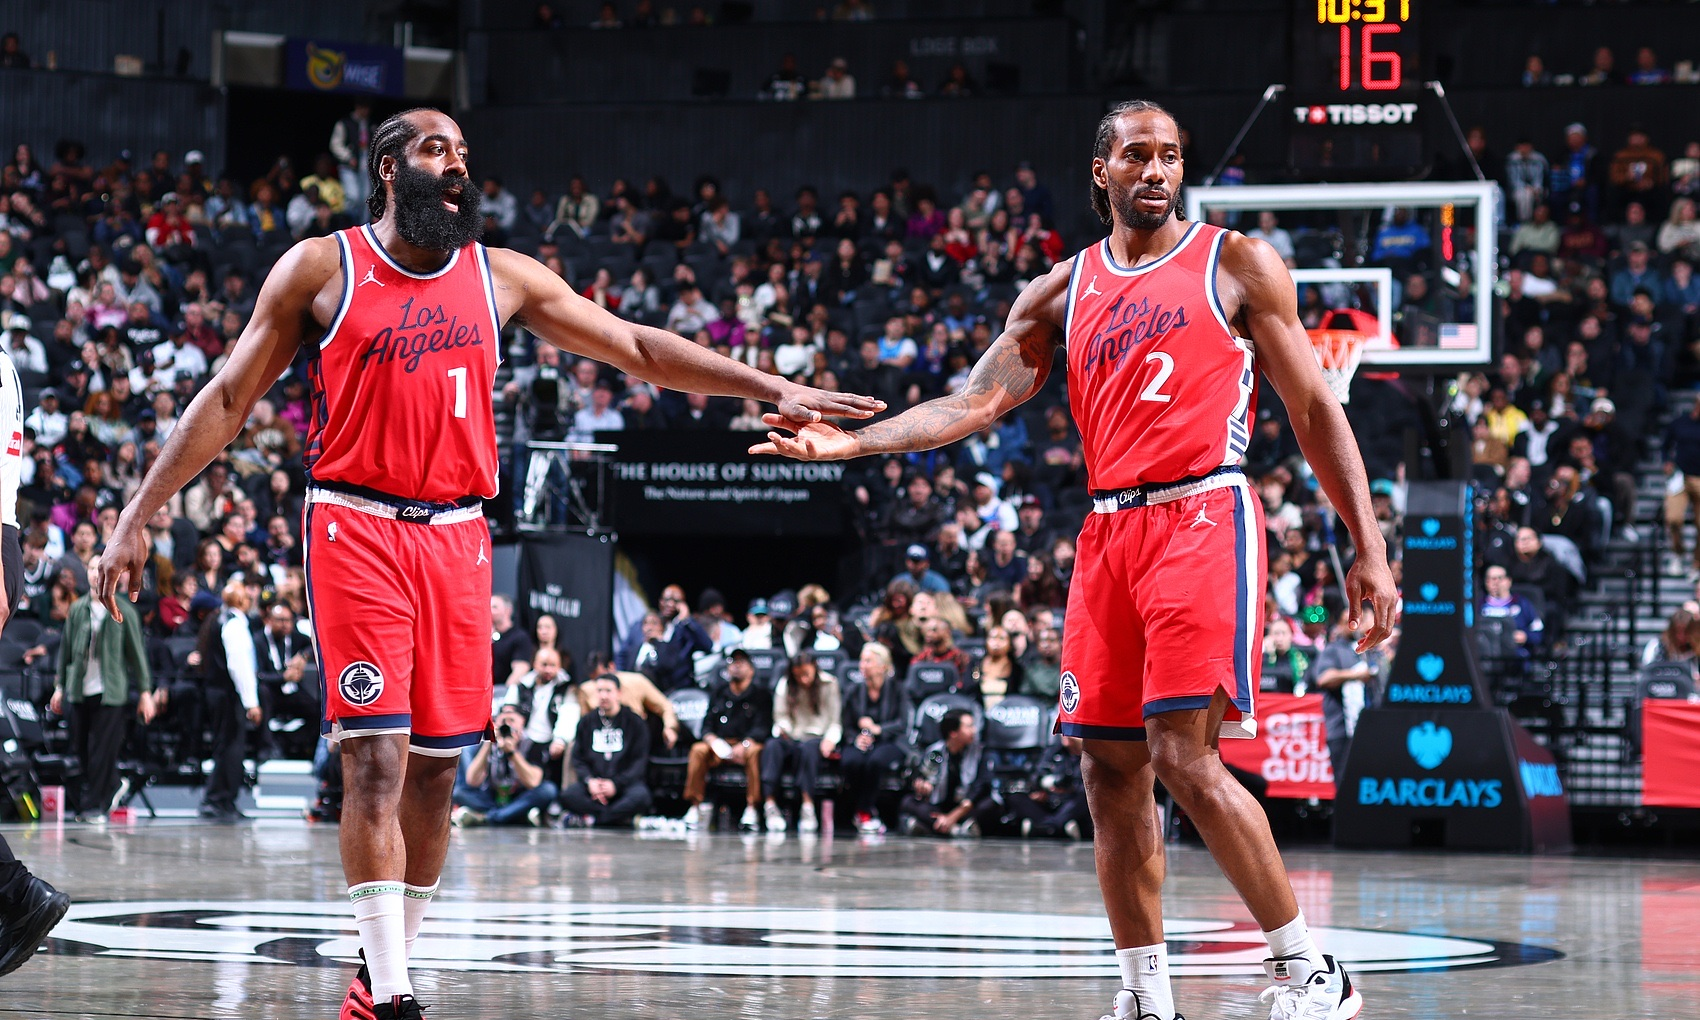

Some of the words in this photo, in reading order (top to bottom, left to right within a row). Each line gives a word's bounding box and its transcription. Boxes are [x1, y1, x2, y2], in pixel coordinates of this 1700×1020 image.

[1340, 24, 1401, 90] 16
[1327, 103, 1418, 125] TISSOT
[397, 296, 449, 332] Los
[1105, 295, 1153, 334] Los
[360, 315, 484, 374] Angeles
[1084, 303, 1191, 381] Angeles
[1140, 350, 1176, 403] 2
[447, 366, 468, 419] 1
[608, 462, 648, 481] THE
[650, 462, 718, 482] HOUSE
[720, 462, 749, 482] OF
[750, 462, 846, 482] SUNTORY
[1119, 487, 1142, 505] Clips
[402, 506, 430, 519] Clips
[1404, 535, 1457, 550] BARCLAYS
[1403, 601, 1456, 615] BARCLAYS
[1388, 683, 1473, 704] BARCLAYS
[1264, 712, 1326, 737] GET
[1358, 776, 1503, 808] BARCLAYS
